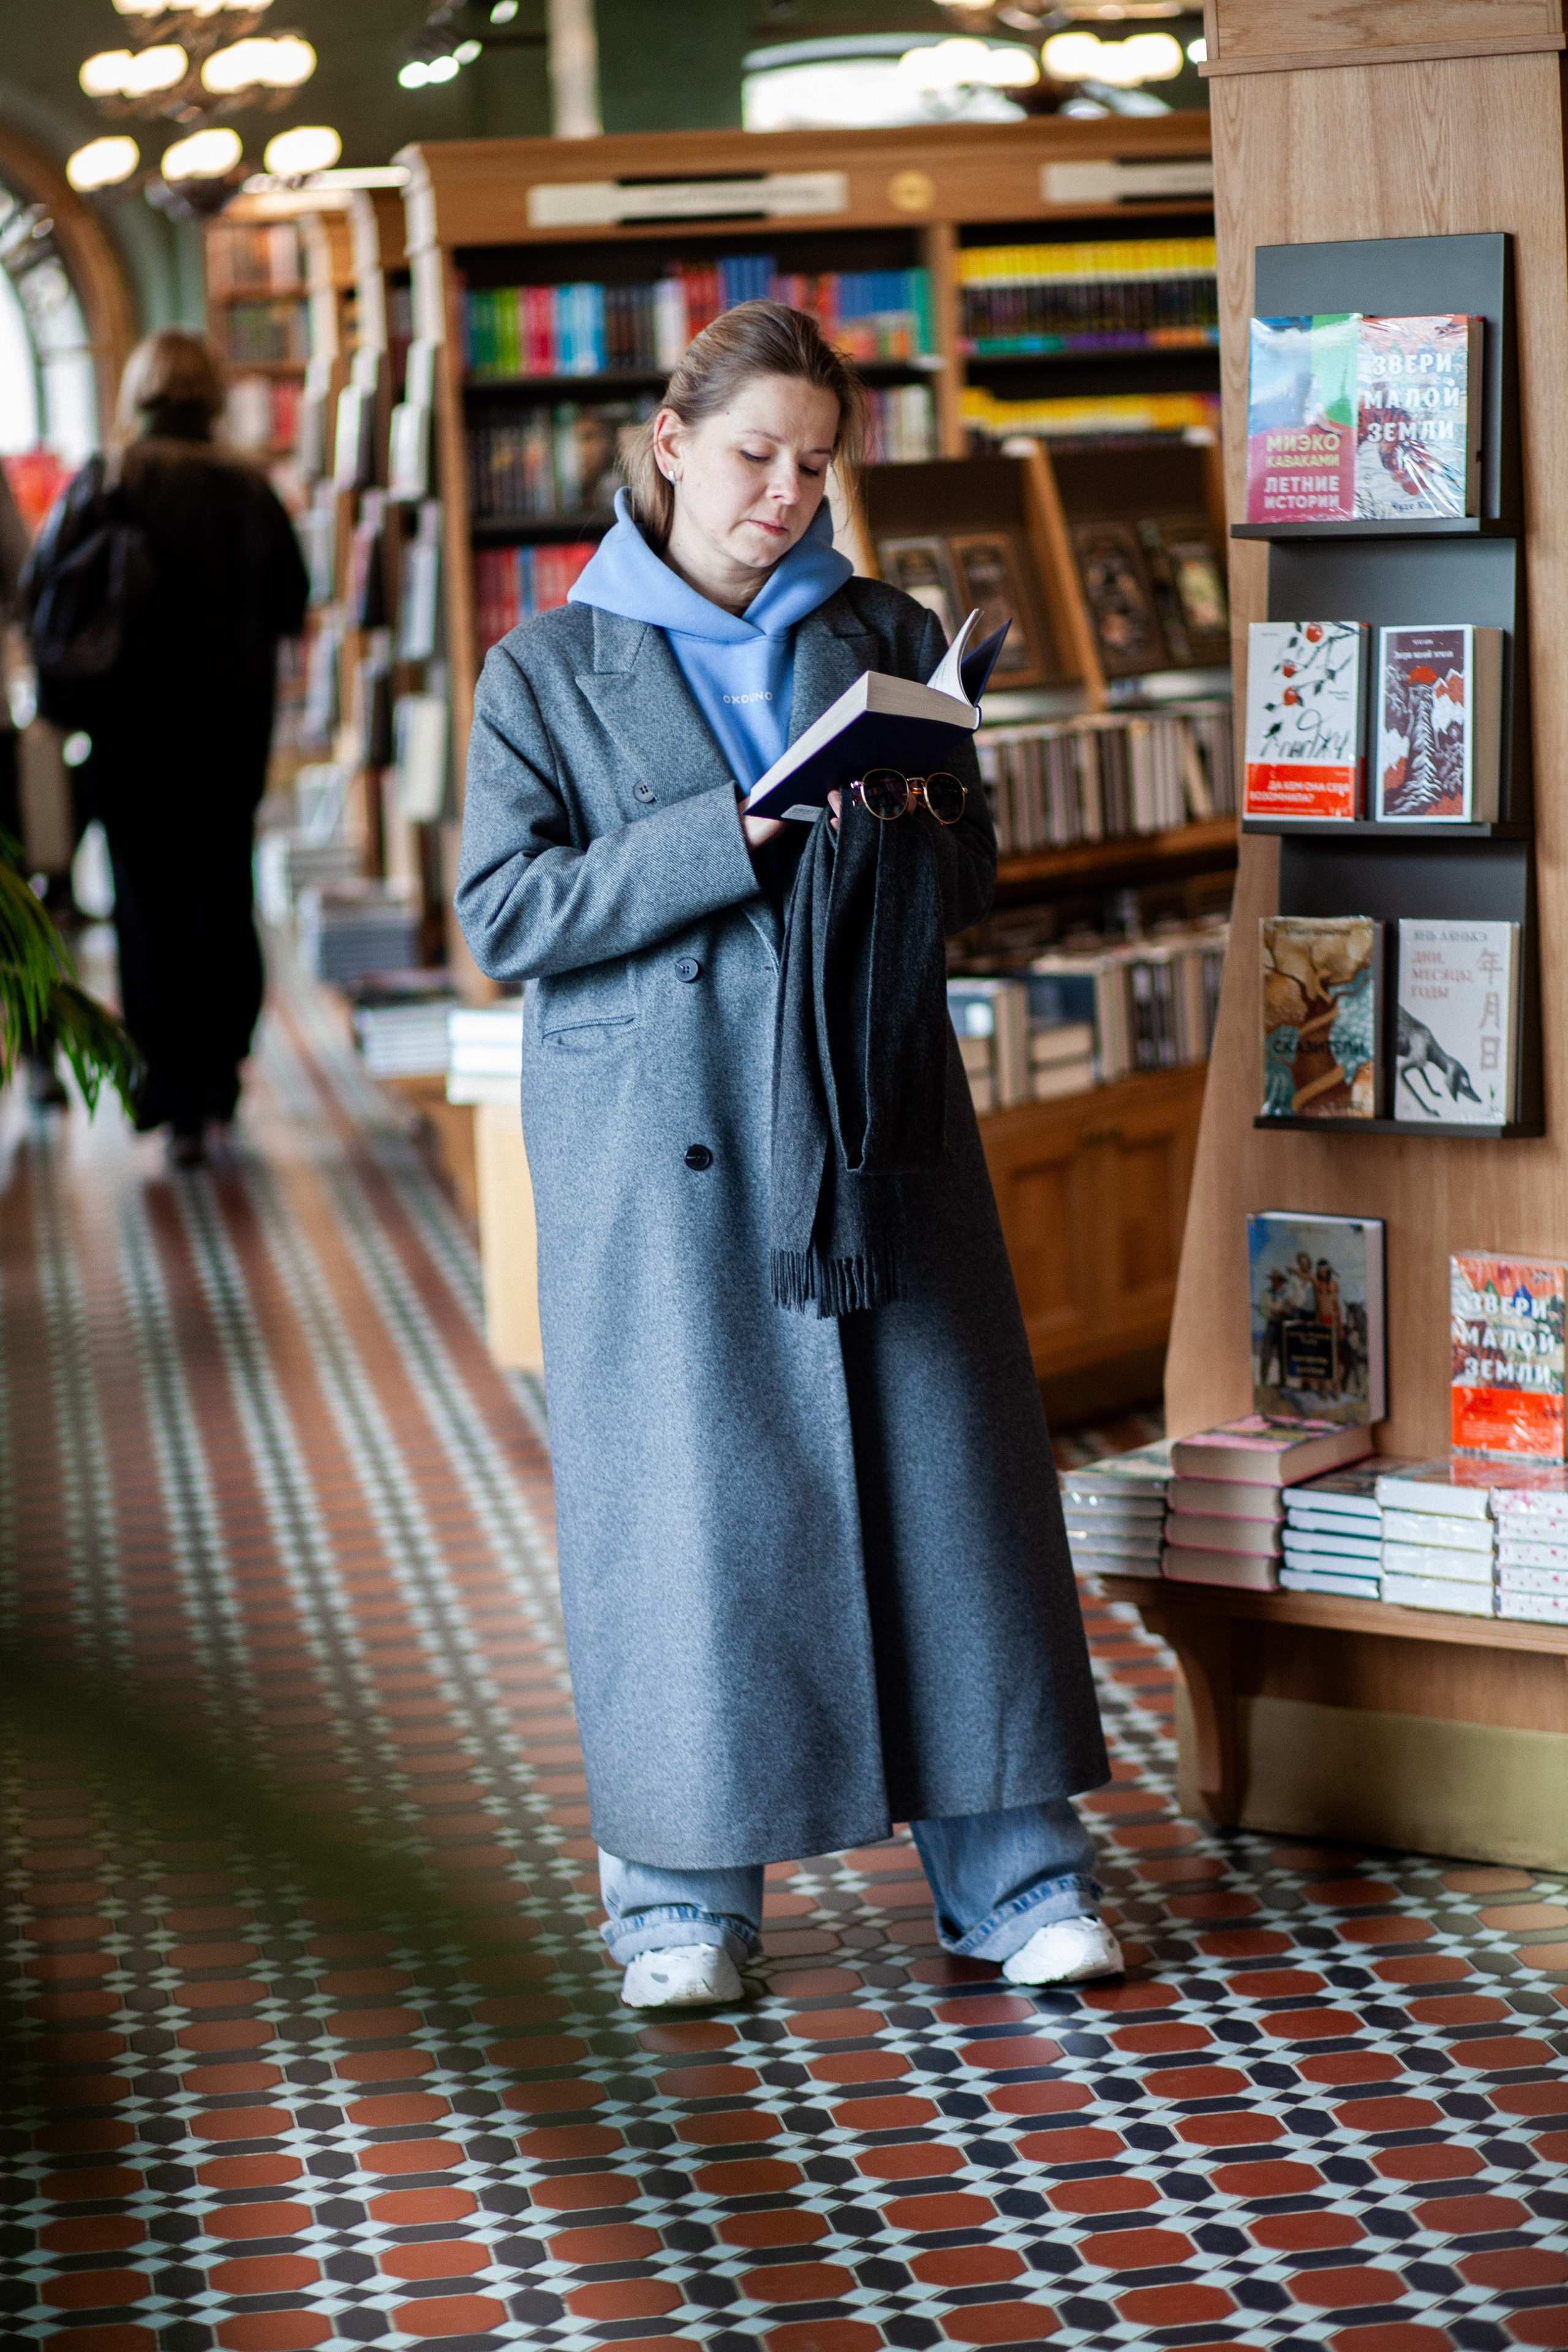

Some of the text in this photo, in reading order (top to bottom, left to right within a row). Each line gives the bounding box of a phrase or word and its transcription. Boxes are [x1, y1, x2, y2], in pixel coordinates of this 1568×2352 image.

[1372, 353, 1452, 375] ЗВЕРИ
[1363, 377, 1460, 410] МАЛОЙ
[1366, 420, 1454, 443] ЗЕМЛИ
[1266, 434, 1341, 452] МИЭКО
[1264, 475, 1340, 494] ЛЕТНИЕ
[1264, 494, 1340, 510] ИСТОРИИ
[723, 691, 773, 704] OXOUNO
[1469, 1291, 1548, 1321] ЗВЕРИ
[1457, 1322, 1556, 1354] МАЛОЙ
[1464, 1356, 1551, 1385] ЗЕМЛИ
